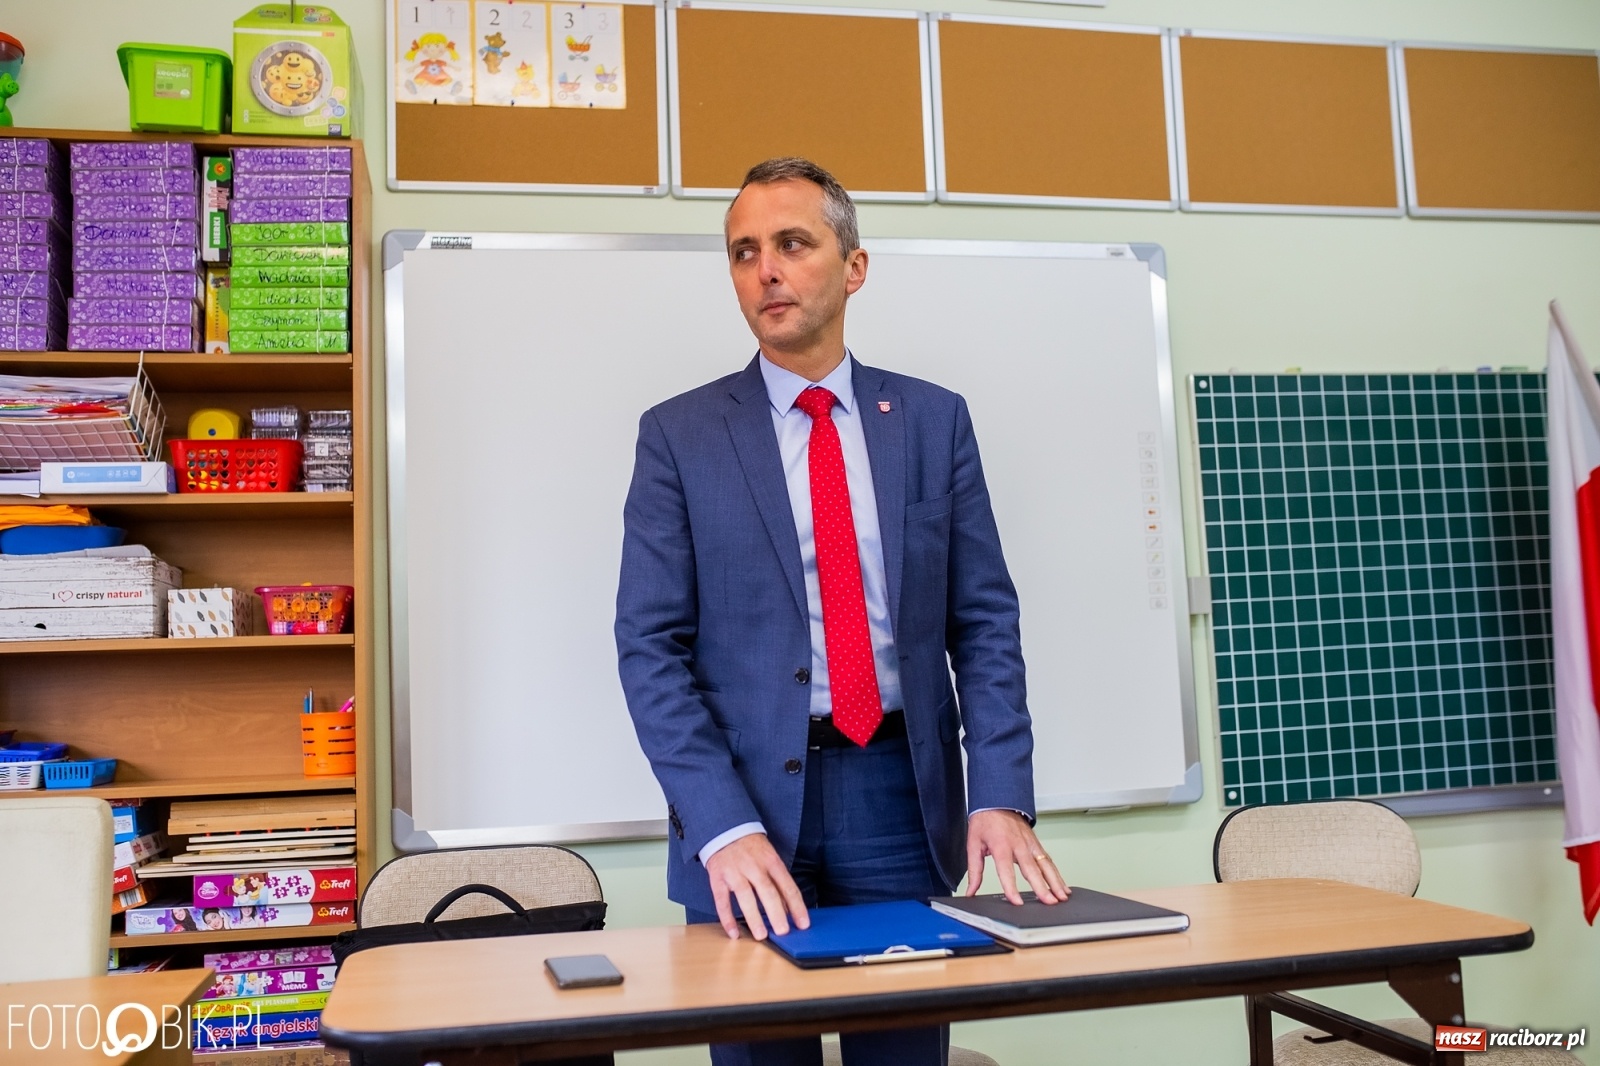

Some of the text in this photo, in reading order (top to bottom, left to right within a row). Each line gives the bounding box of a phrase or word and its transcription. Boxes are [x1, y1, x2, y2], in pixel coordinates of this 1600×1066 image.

[414, 6, 419, 23] 1
[489, 9, 500, 26] 2
[564, 12, 574, 29] 3
[212, 216, 221, 245] BIERKI
[76, 592, 105, 600] crispy
[107, 590, 142, 599] natural
[330, 879, 351, 890] Trefl
[329, 907, 349, 917] Trefl
[206, 1016, 318, 1042] język angielski
